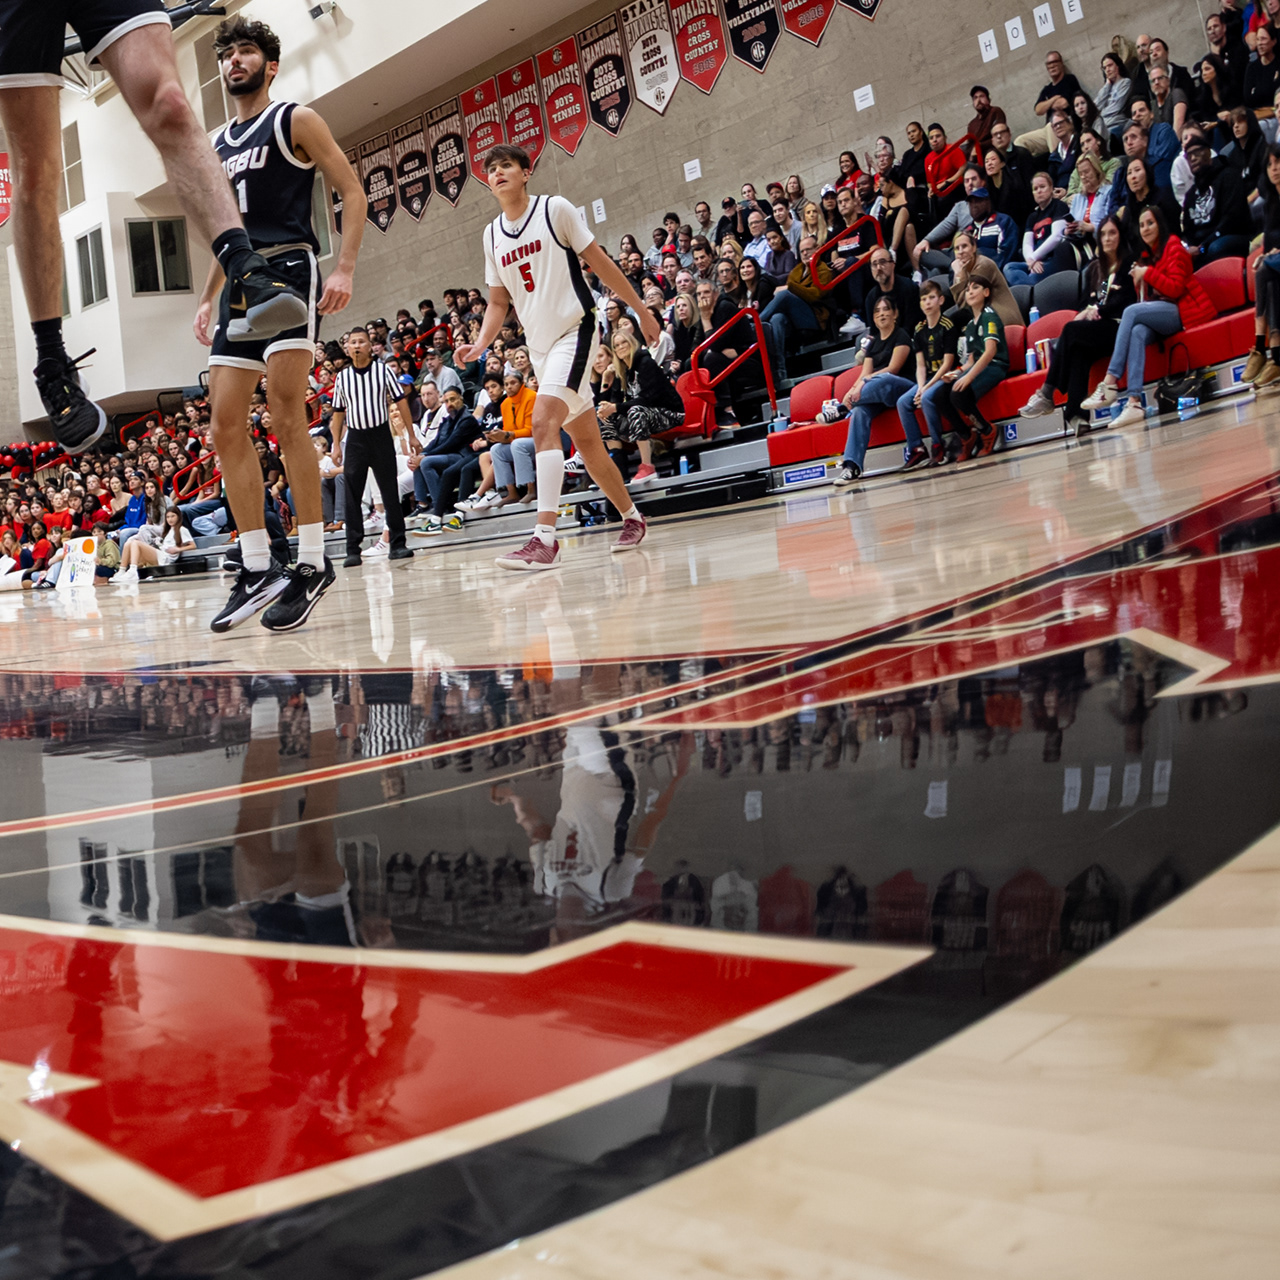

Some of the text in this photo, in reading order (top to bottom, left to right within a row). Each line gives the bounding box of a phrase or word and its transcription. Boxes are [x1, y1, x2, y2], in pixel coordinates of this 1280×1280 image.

[728, 0, 775, 29] VOLLEYBALL
[688, 19, 706, 34] BOYS
[688, 30, 710, 47] CROSS
[582, 32, 621, 73] CHAMPIONS
[685, 39, 719, 62] COUNTRY
[593, 70, 617, 89] CROSS
[594, 60, 613, 78] BOYS
[542, 62, 581, 102] FINALISTS
[591, 76, 626, 101] COUNTRY
[502, 83, 538, 120] FINALISTS
[555, 93, 574, 109] BOYS
[465, 101, 500, 138] FINALISTS
[552, 104, 581, 123] TENNIS
[477, 136, 494, 149] CROSS
[435, 153, 465, 174] COUNTRY
[501, 240, 541, 267] OAKWOOD
[518, 262, 535, 293] 5
